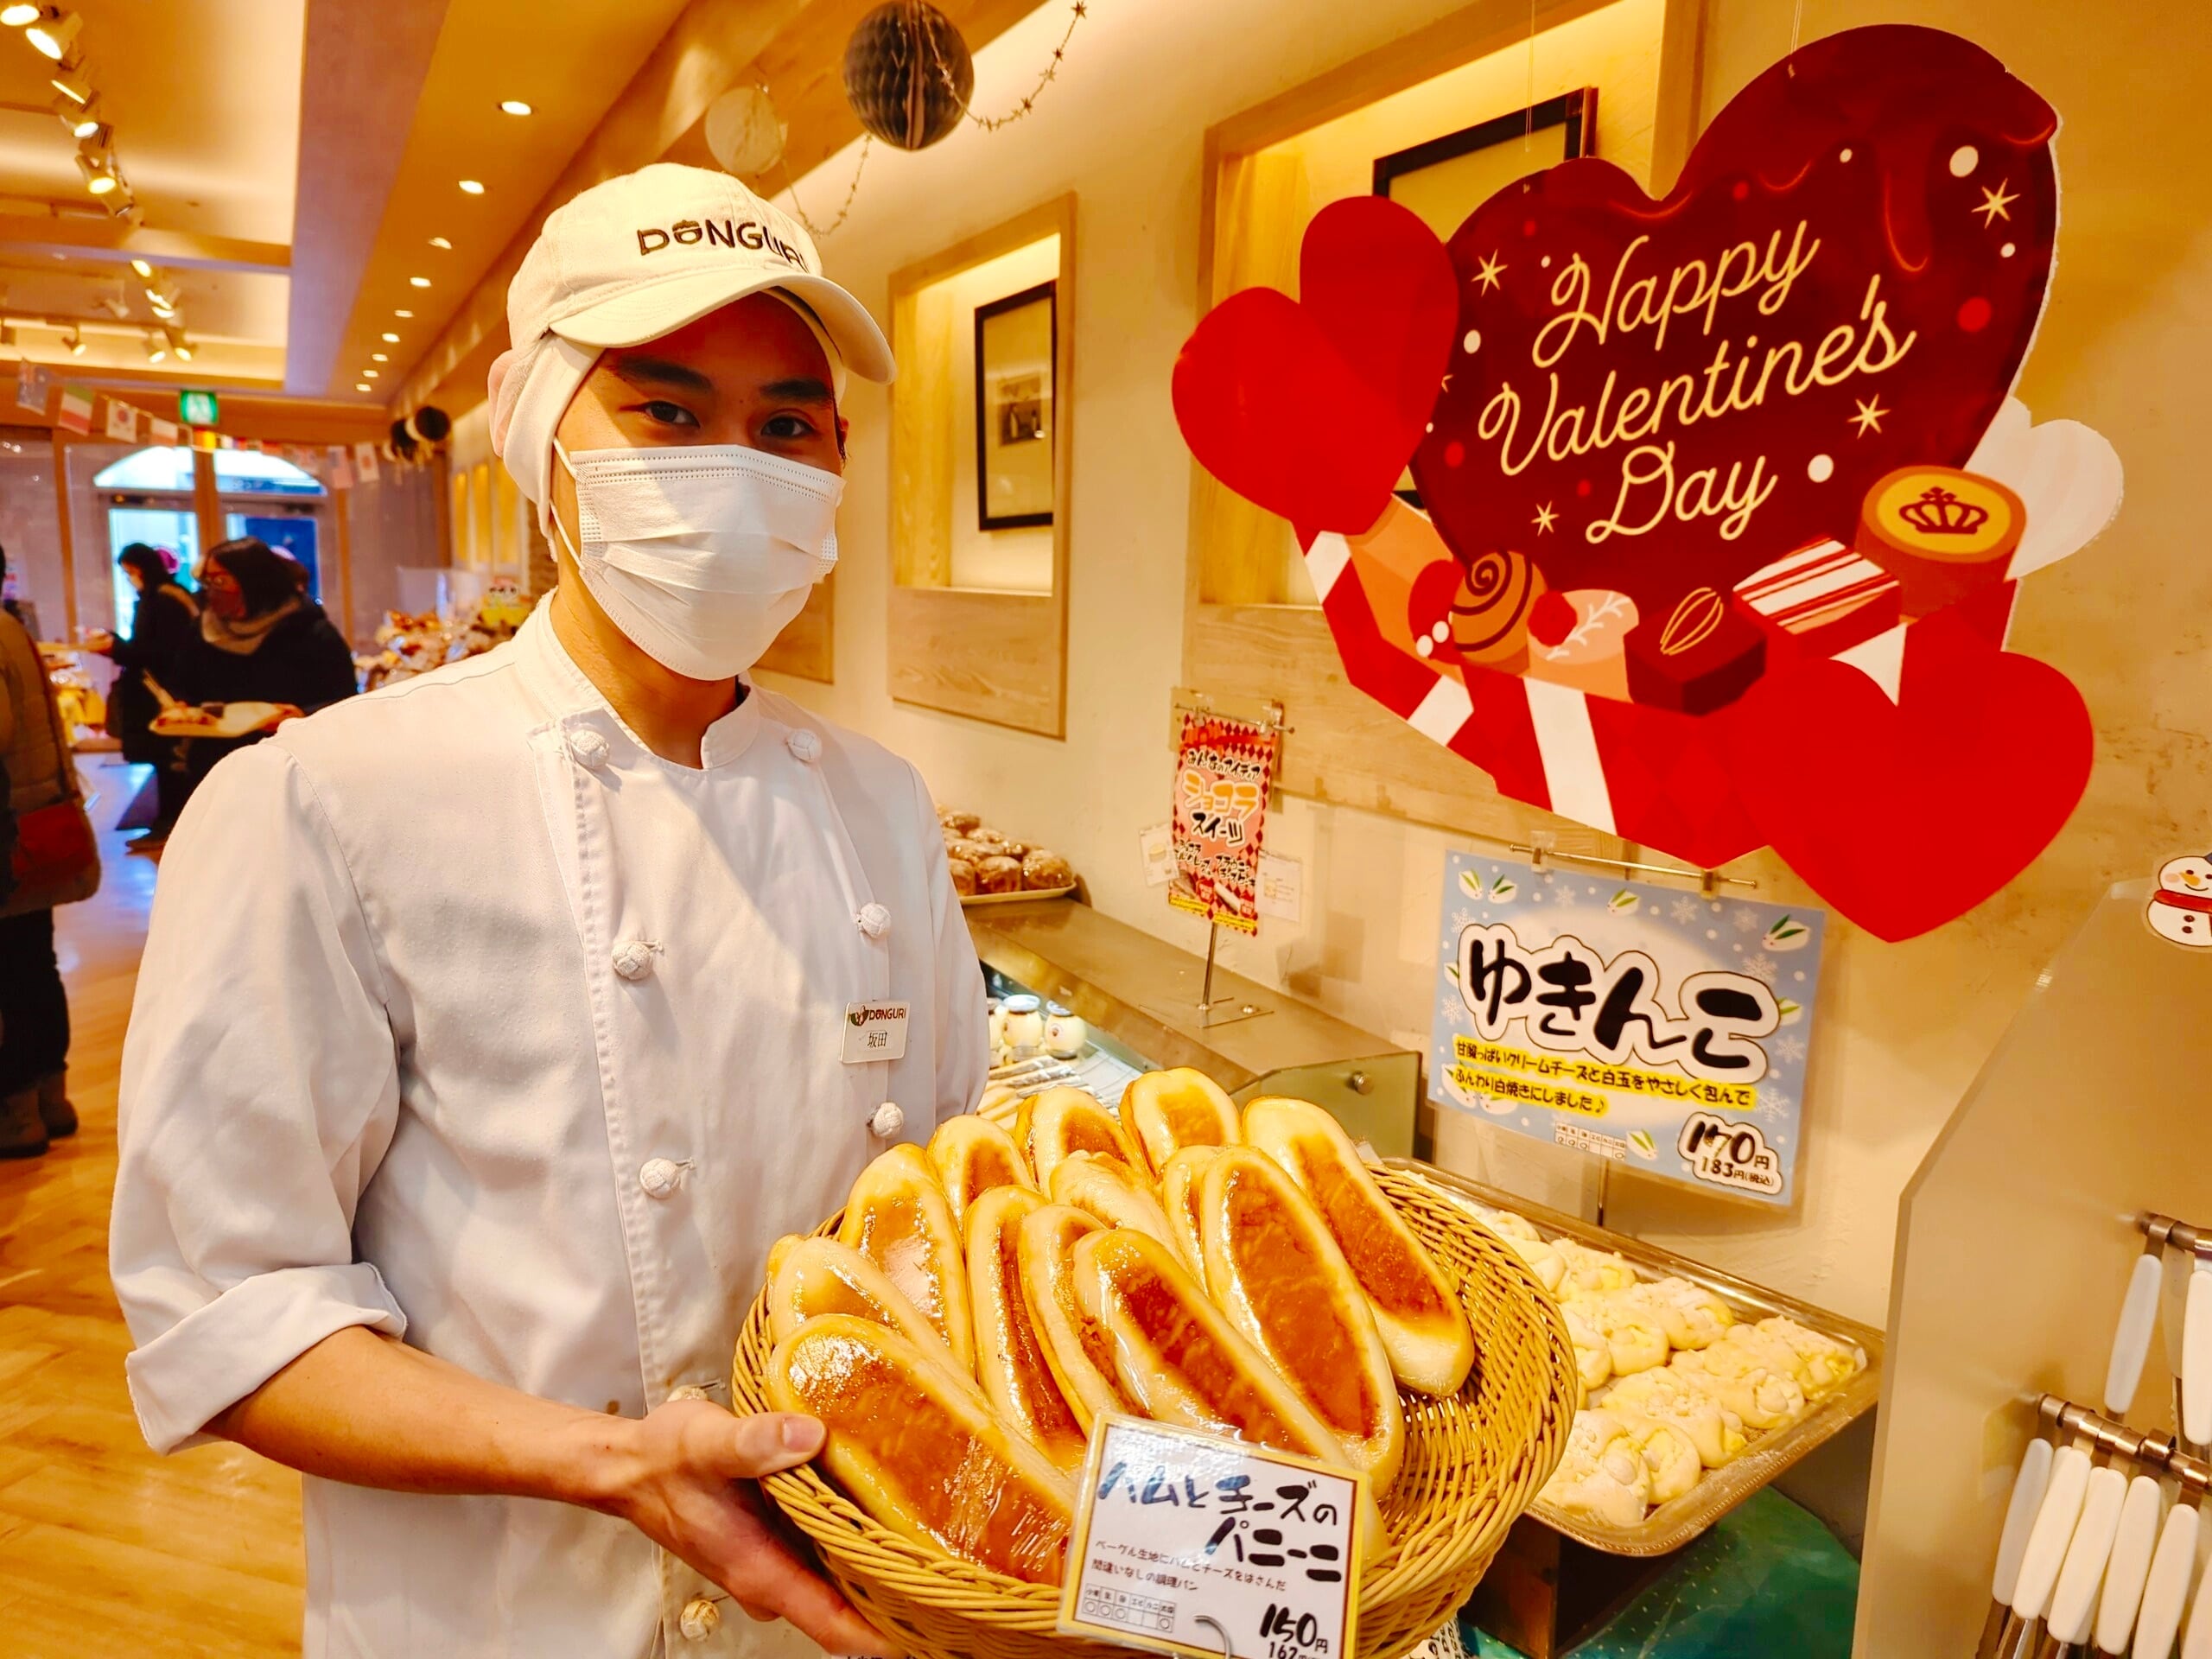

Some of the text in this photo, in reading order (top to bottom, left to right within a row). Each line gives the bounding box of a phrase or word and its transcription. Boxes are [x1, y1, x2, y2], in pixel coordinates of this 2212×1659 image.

[636, 219, 810, 274] DONGURI
[1531, 219, 1821, 368] Happy
[1478, 273, 1917, 476] Valentine's
[1585, 441, 1778, 544] Day
[1184, 771, 1258, 821] ショコラ
[1192, 811, 1243, 844] スイーツ
[868, 1007, 906, 1020] DONGURI
[1470, 938, 1763, 1069] ゆきんこ
[867, 1032, 887, 1048] 坂田
[1456, 1039, 1751, 1106] 甘酸っぱいクリームチーズと白玉をやさしく包んで
[1097, 1461, 1338, 1527] ハムとチーズの
[1090, 1558, 1199, 1592] 間違いなしの調理パン
[1205, 1516, 1343, 1583] パニーニ
[1259, 1603, 1328, 1654] 150円
